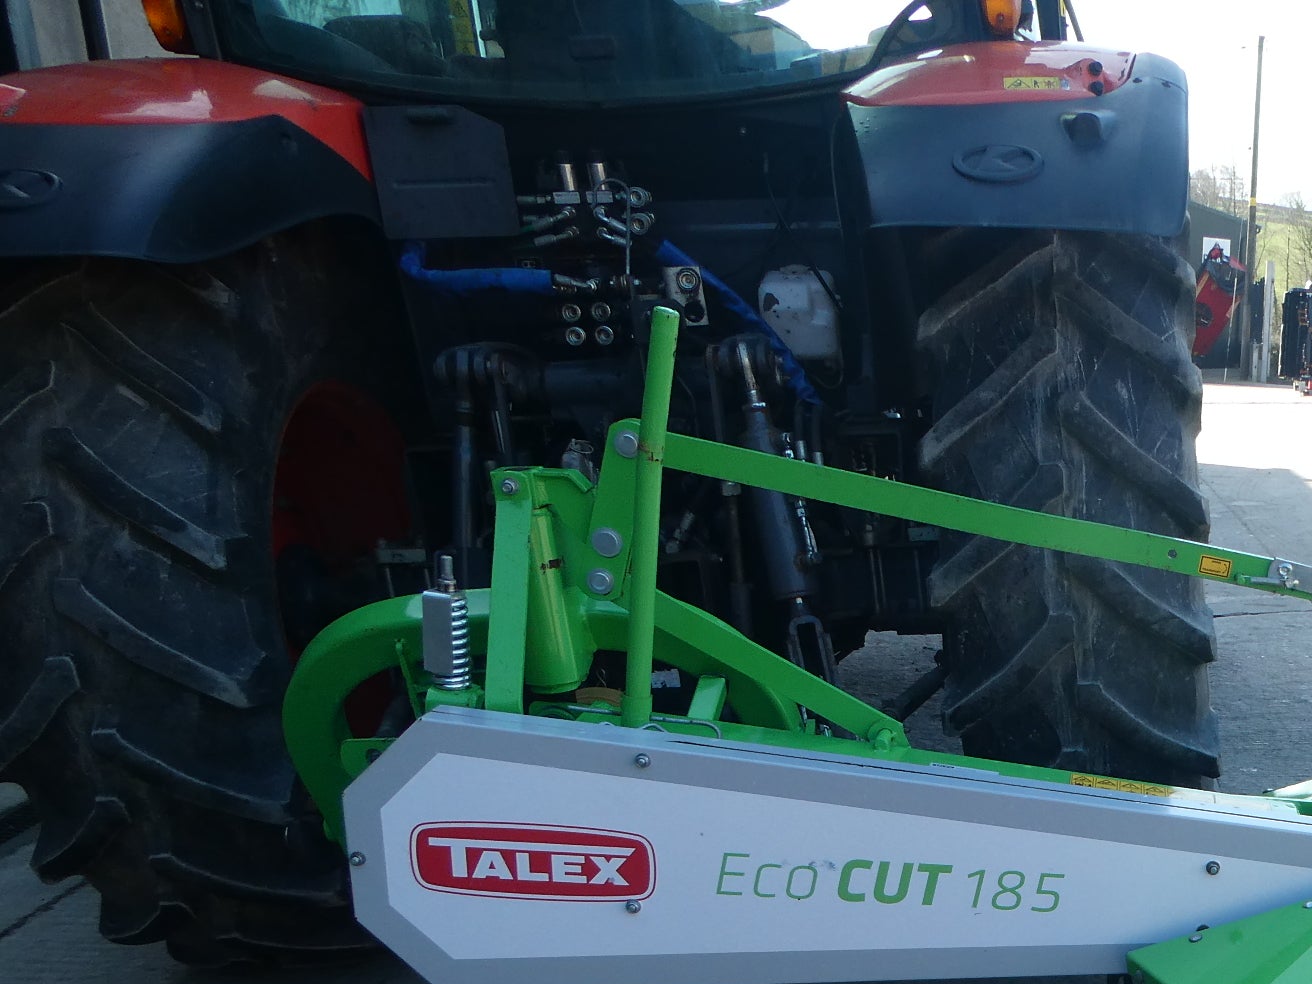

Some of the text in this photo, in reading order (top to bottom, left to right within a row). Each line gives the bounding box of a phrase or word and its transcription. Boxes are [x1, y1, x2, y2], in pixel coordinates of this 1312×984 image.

[428, 837, 636, 886] TALEX
[837, 859, 953, 906] CUT
[967, 869, 1065, 912] 185
